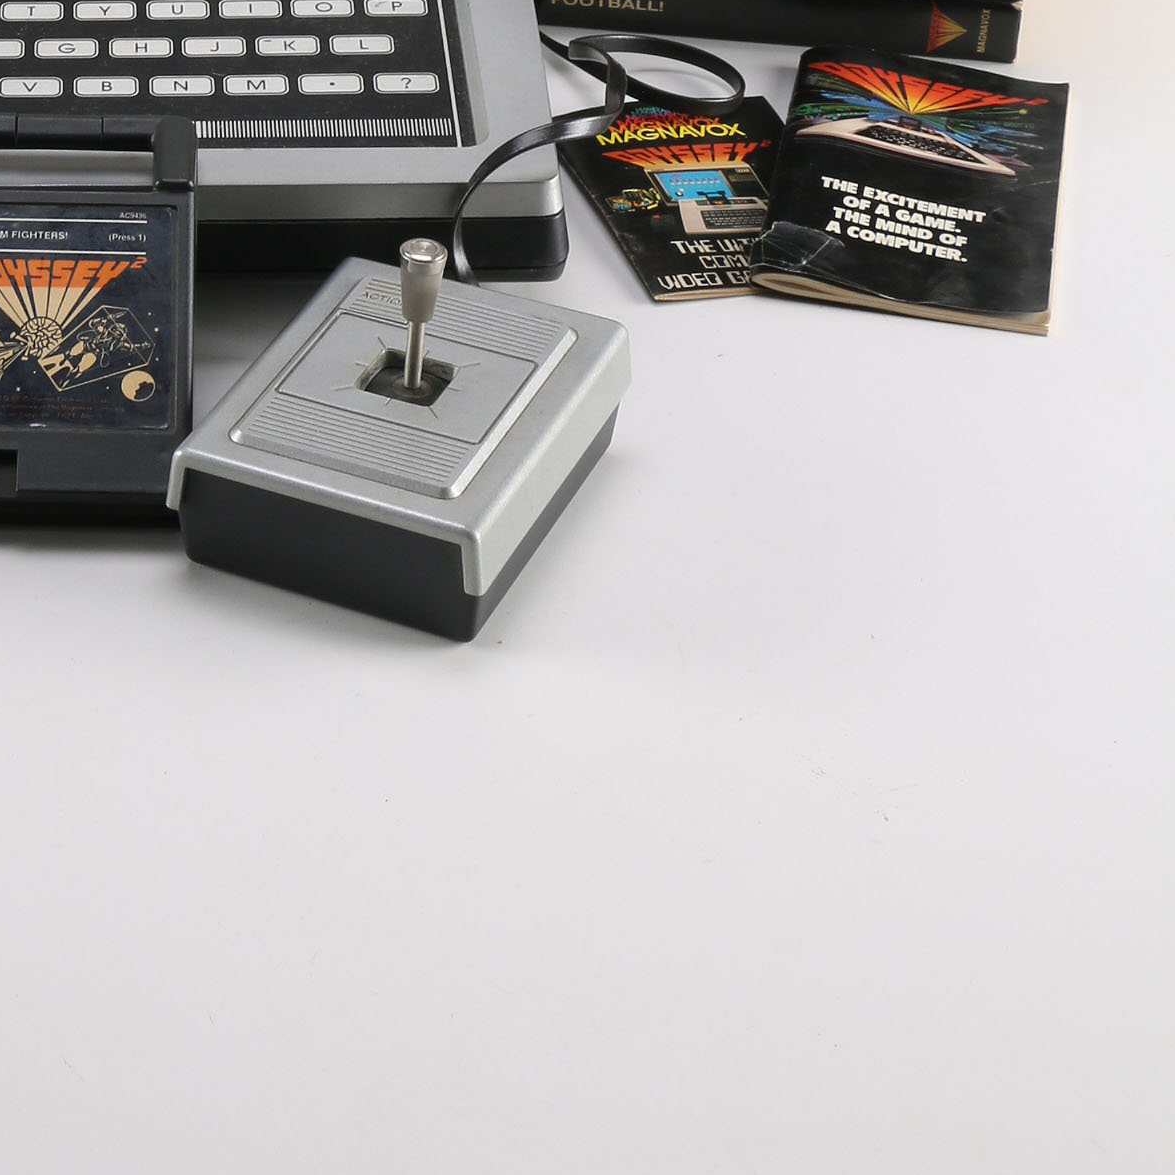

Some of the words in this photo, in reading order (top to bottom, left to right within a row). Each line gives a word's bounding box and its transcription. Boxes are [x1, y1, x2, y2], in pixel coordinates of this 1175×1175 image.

[27, 5, 36, 17] T
[99, 5, 111, 16] Y
[171, 4, 184, 15] U
[248, 3, 253, 14] I
[314, 1, 333, 13] O
[391, 1, 403, 12] P
[977, 9, 991, 54] MAGNAVOX
[57, 42, 76, 54] G
[135, 42, 148, 53] H
[210, 41, 220, 52] J
[283, 40, 296, 51] K
[359, 39, 369, 50] L
[22, 81, 38, 93] V
[101, 81, 113, 92] B
[173, 80, 188, 91] N
[246, 79, 267, 92] M
[596, 123, 746, 147] MAGNAVOX
[821, 176, 858, 195] THE
[862, 186, 986, 223] EXCITEMENT
[843, 196, 872, 211] OF
[875, 203, 891, 217] A
[895, 209, 962, 233] GAME.
[833, 207, 871, 227] THE
[875, 218, 933, 241] MIND
[939, 232, 968, 247] OF
[11, 230, 69, 241] FIGHTERS!
[108, 233, 136, 243] (Press
[138, 234, 147, 243] 1)
[825, 220, 841, 234] A
[846, 225, 968, 262] COMPUTER.
[670, 239, 717, 254] THE
[657, 272, 724, 290] VIDEO
[363, 290, 403, 307] ACTIO
